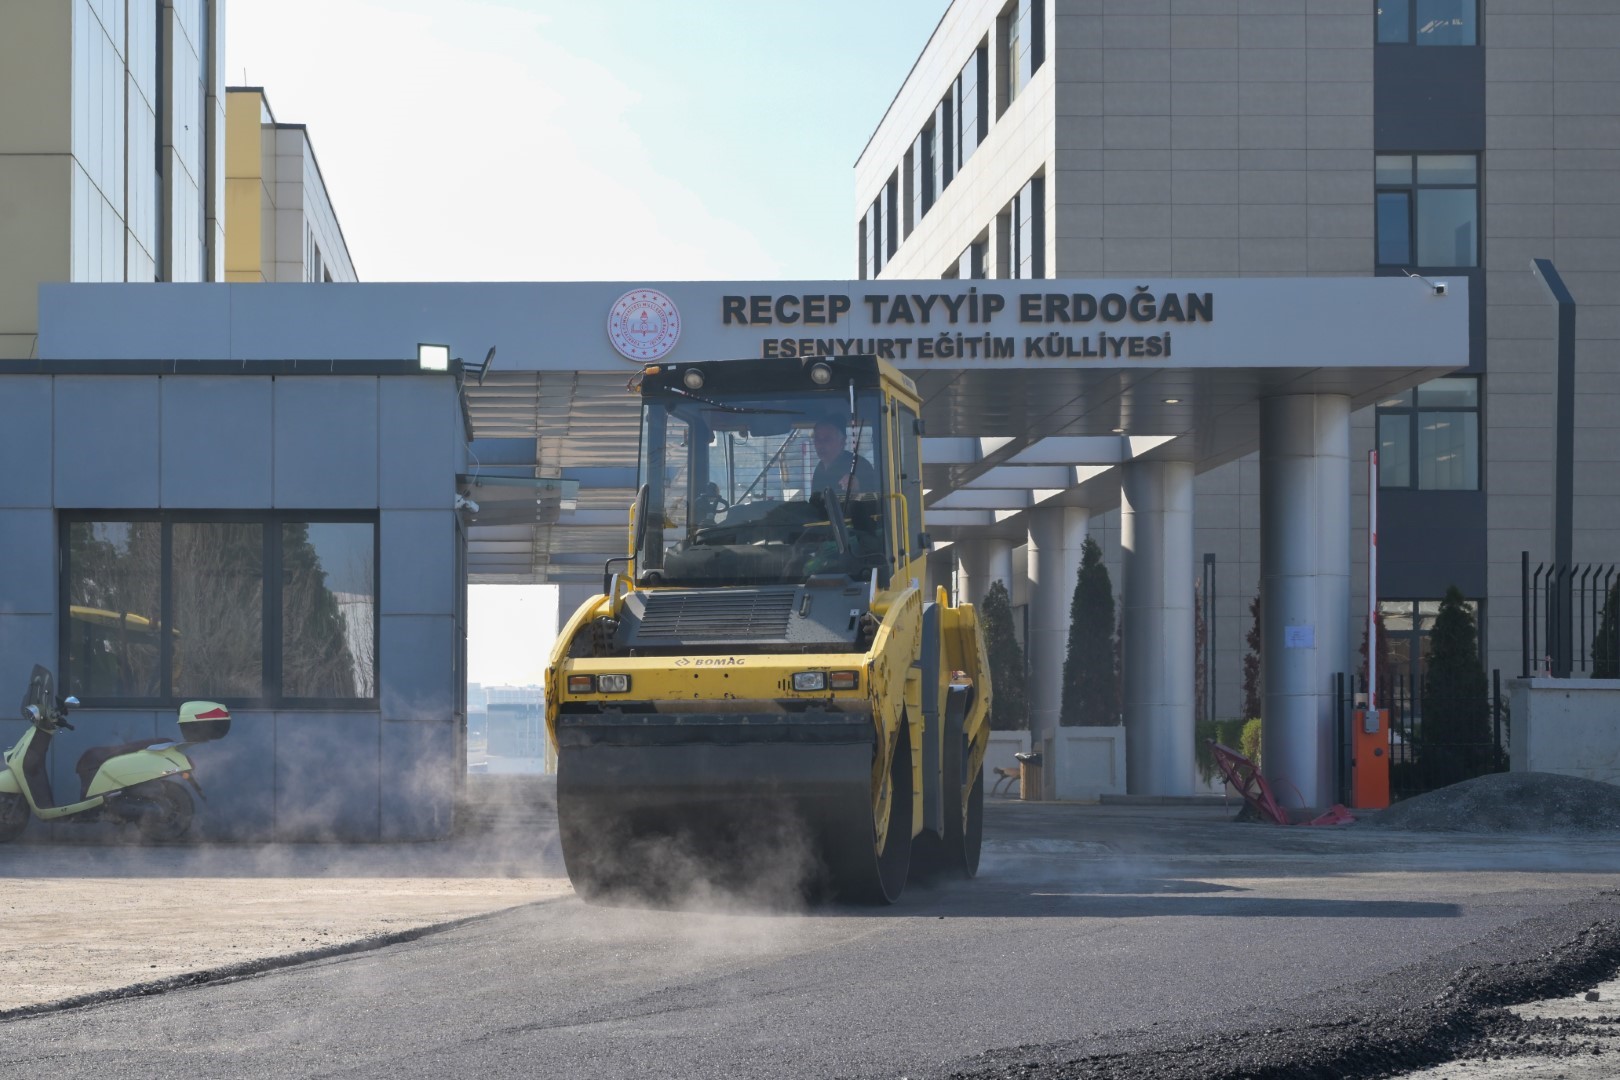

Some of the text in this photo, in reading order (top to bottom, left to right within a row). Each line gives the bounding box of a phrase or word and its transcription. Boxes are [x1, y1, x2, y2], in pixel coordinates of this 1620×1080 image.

[722, 285, 1214, 325] RECEP TAYYİP ERDOĞAN
[763, 331, 1172, 359] ESENYURT EĞİTİM KÜLLİYESİ
[695, 658, 745, 666] BOMAG
